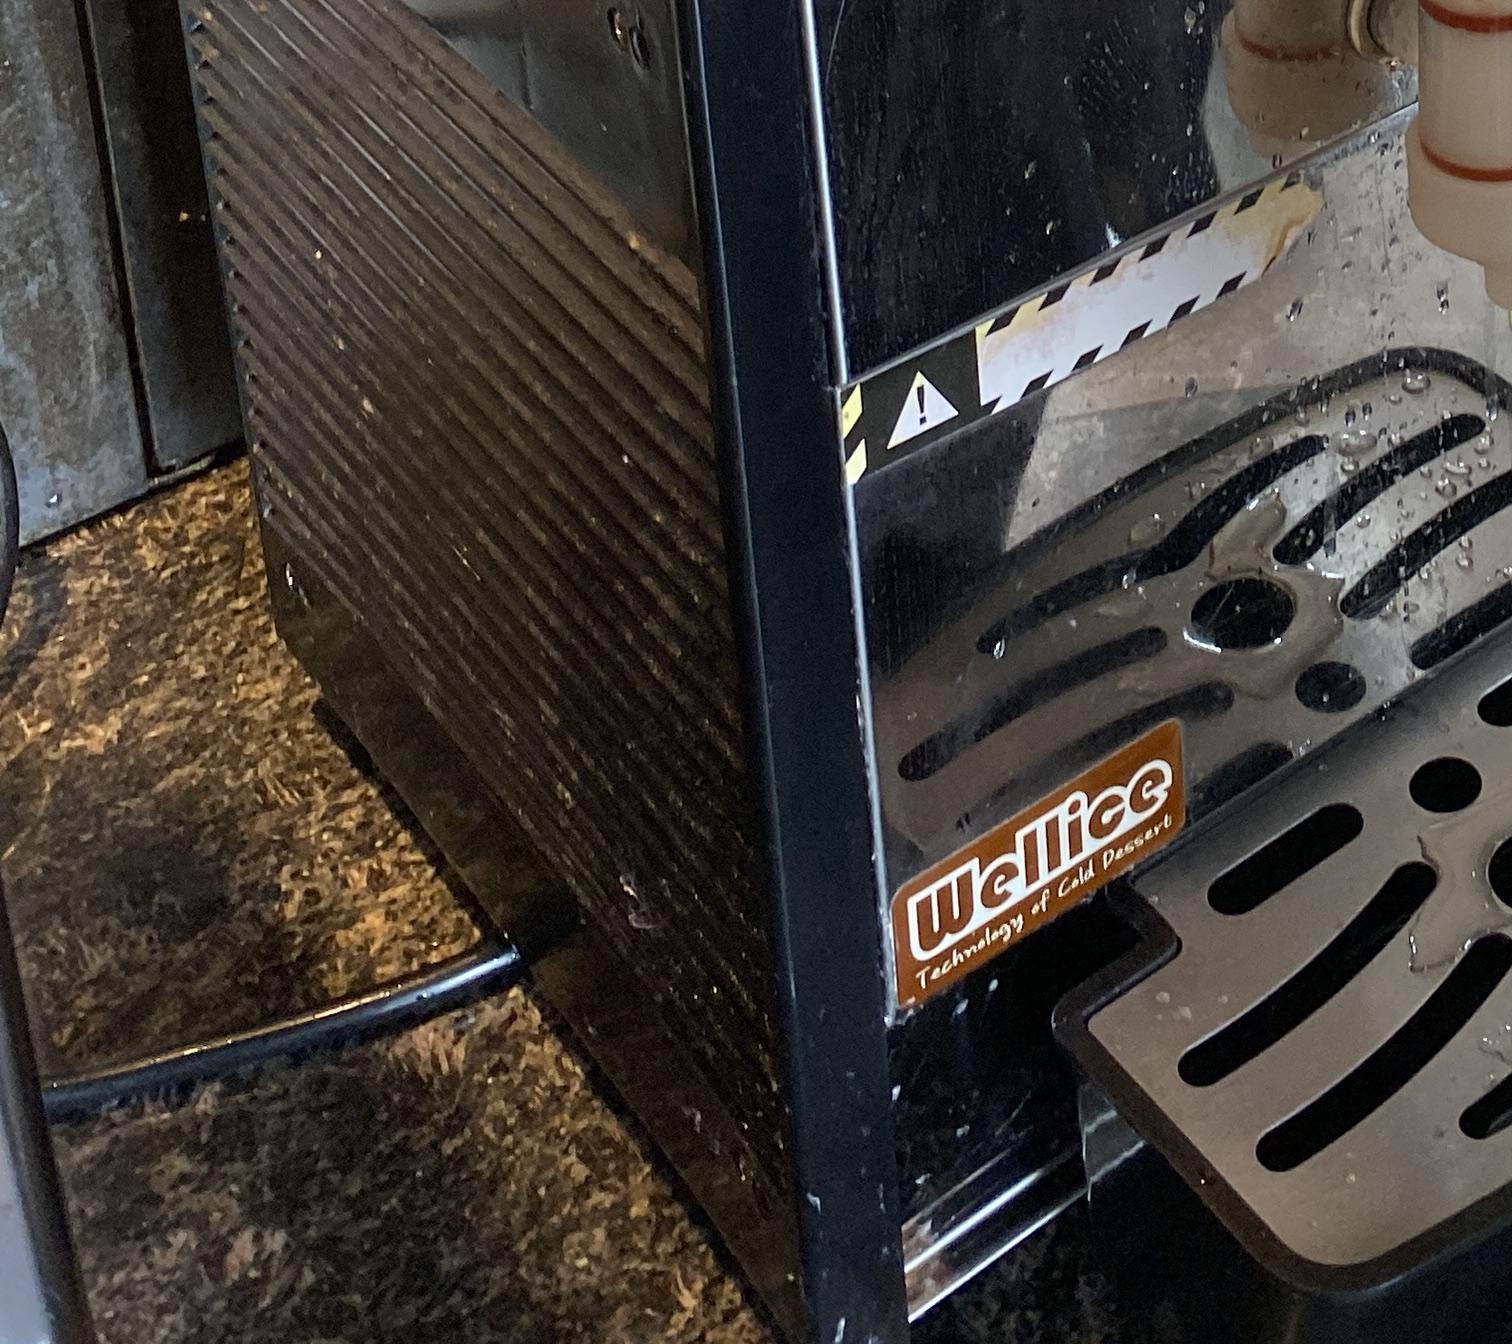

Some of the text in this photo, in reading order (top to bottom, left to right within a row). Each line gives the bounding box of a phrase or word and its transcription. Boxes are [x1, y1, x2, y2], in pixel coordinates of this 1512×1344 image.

[907, 758, 1174, 962] Wellice
[915, 813, 1173, 990] Technology of Cold Dessert
